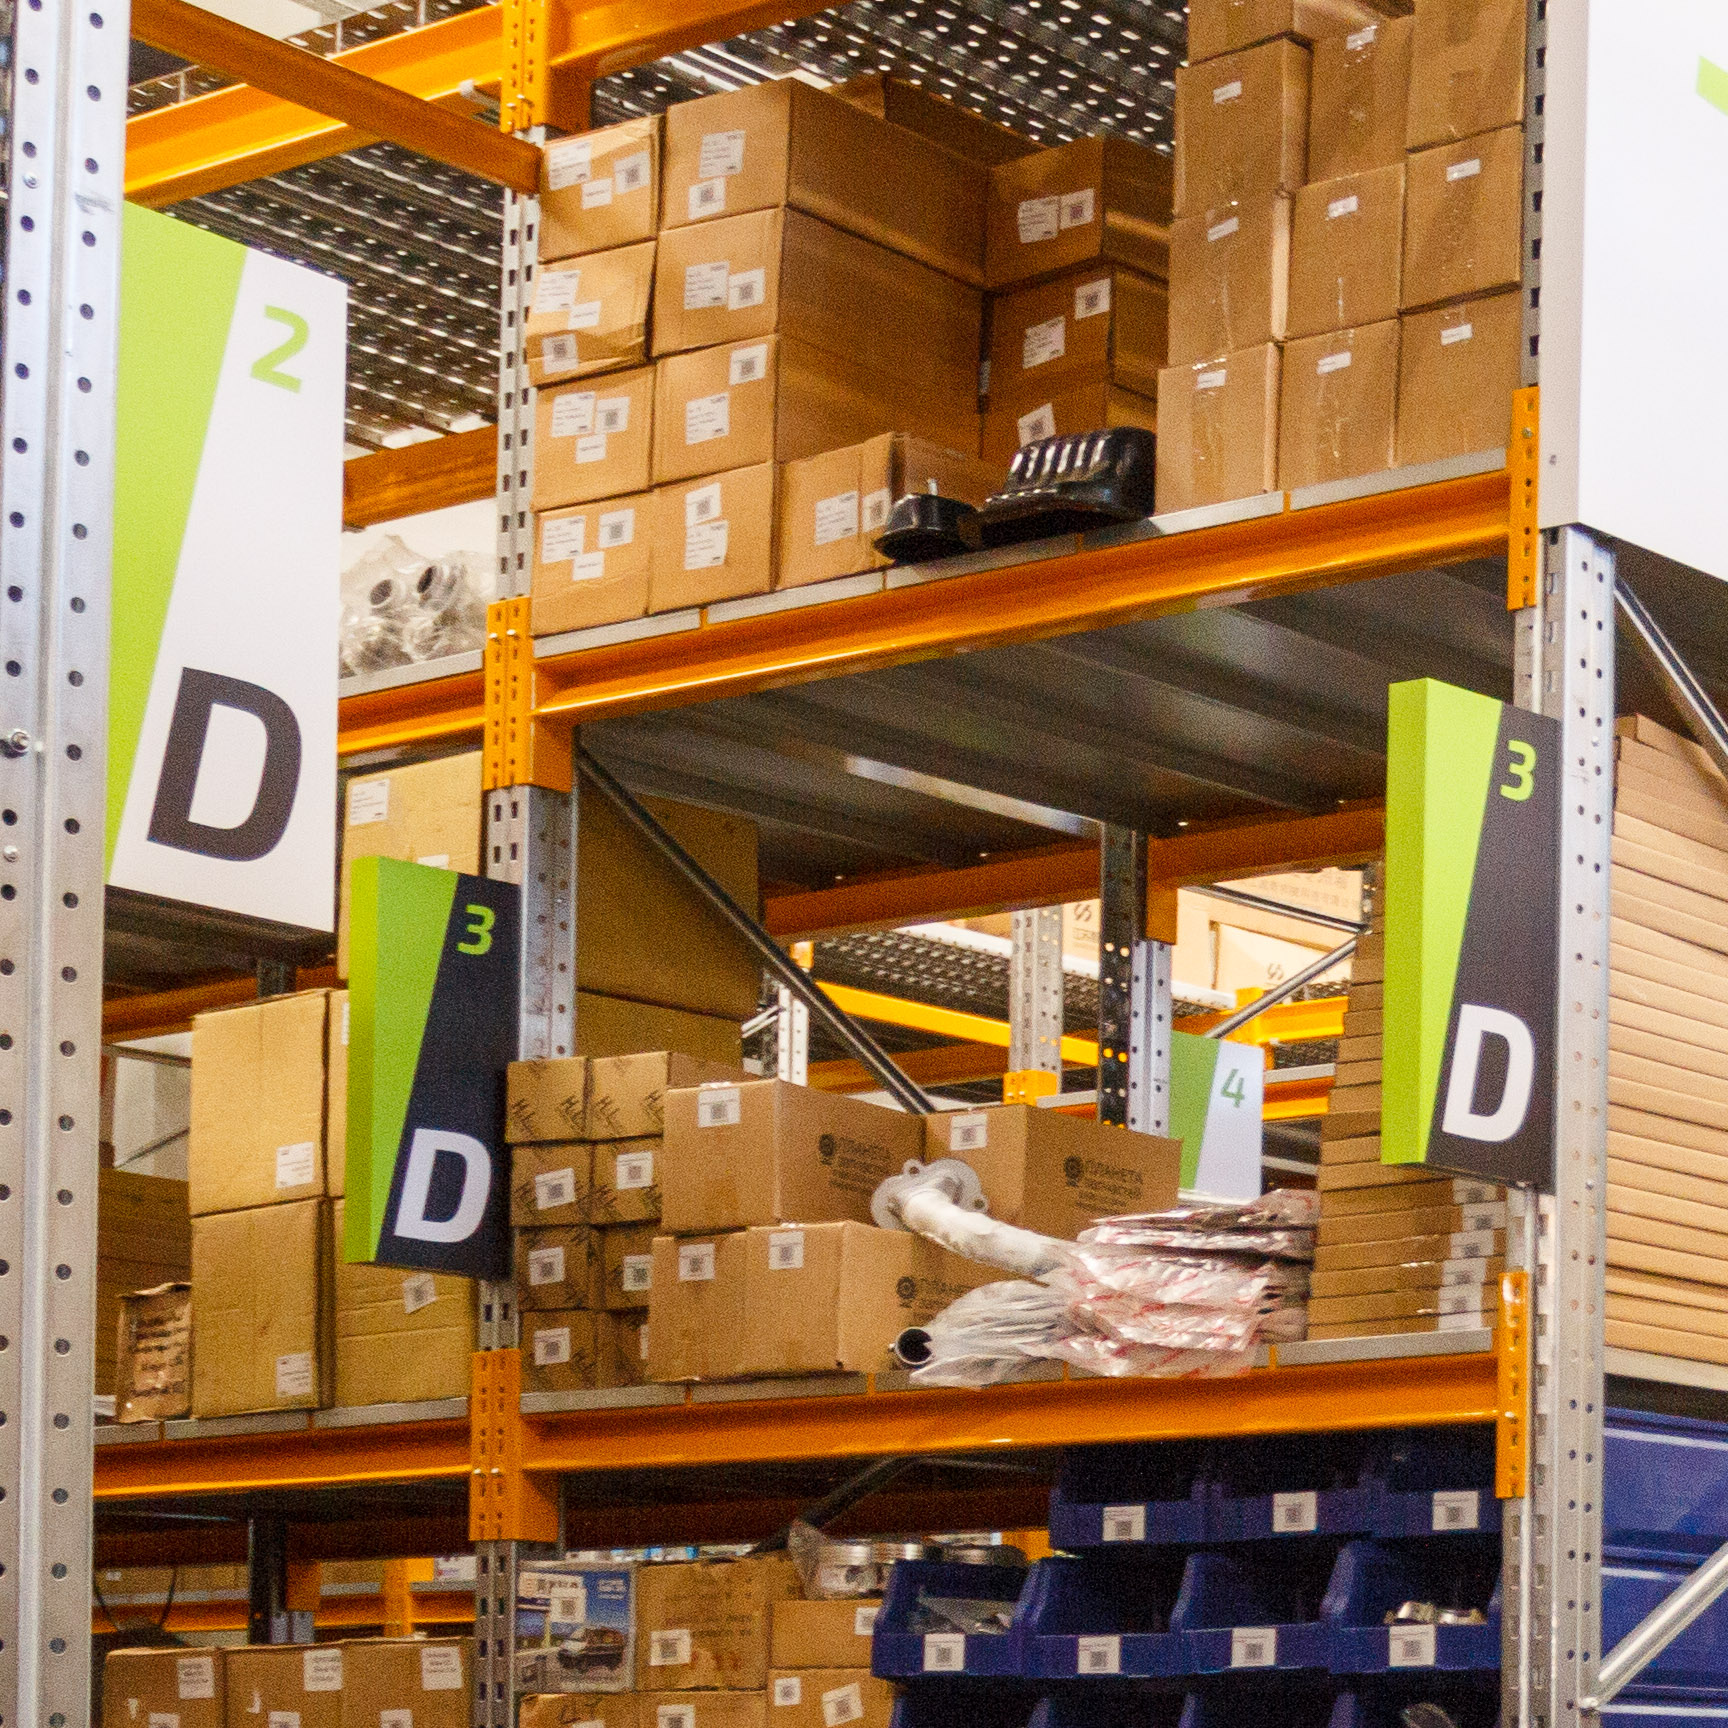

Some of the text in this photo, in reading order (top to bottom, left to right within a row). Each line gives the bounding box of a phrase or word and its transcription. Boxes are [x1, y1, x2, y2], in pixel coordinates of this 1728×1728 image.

[251, 306, 311, 393] 2
[147, 667, 303, 862] D
[1500, 740, 1536, 801] 3
[457, 905, 497, 956] 3
[1220, 1067, 1246, 1109] 4
[1442, 1004, 1536, 1142] D
[394, 1128, 494, 1243] D
